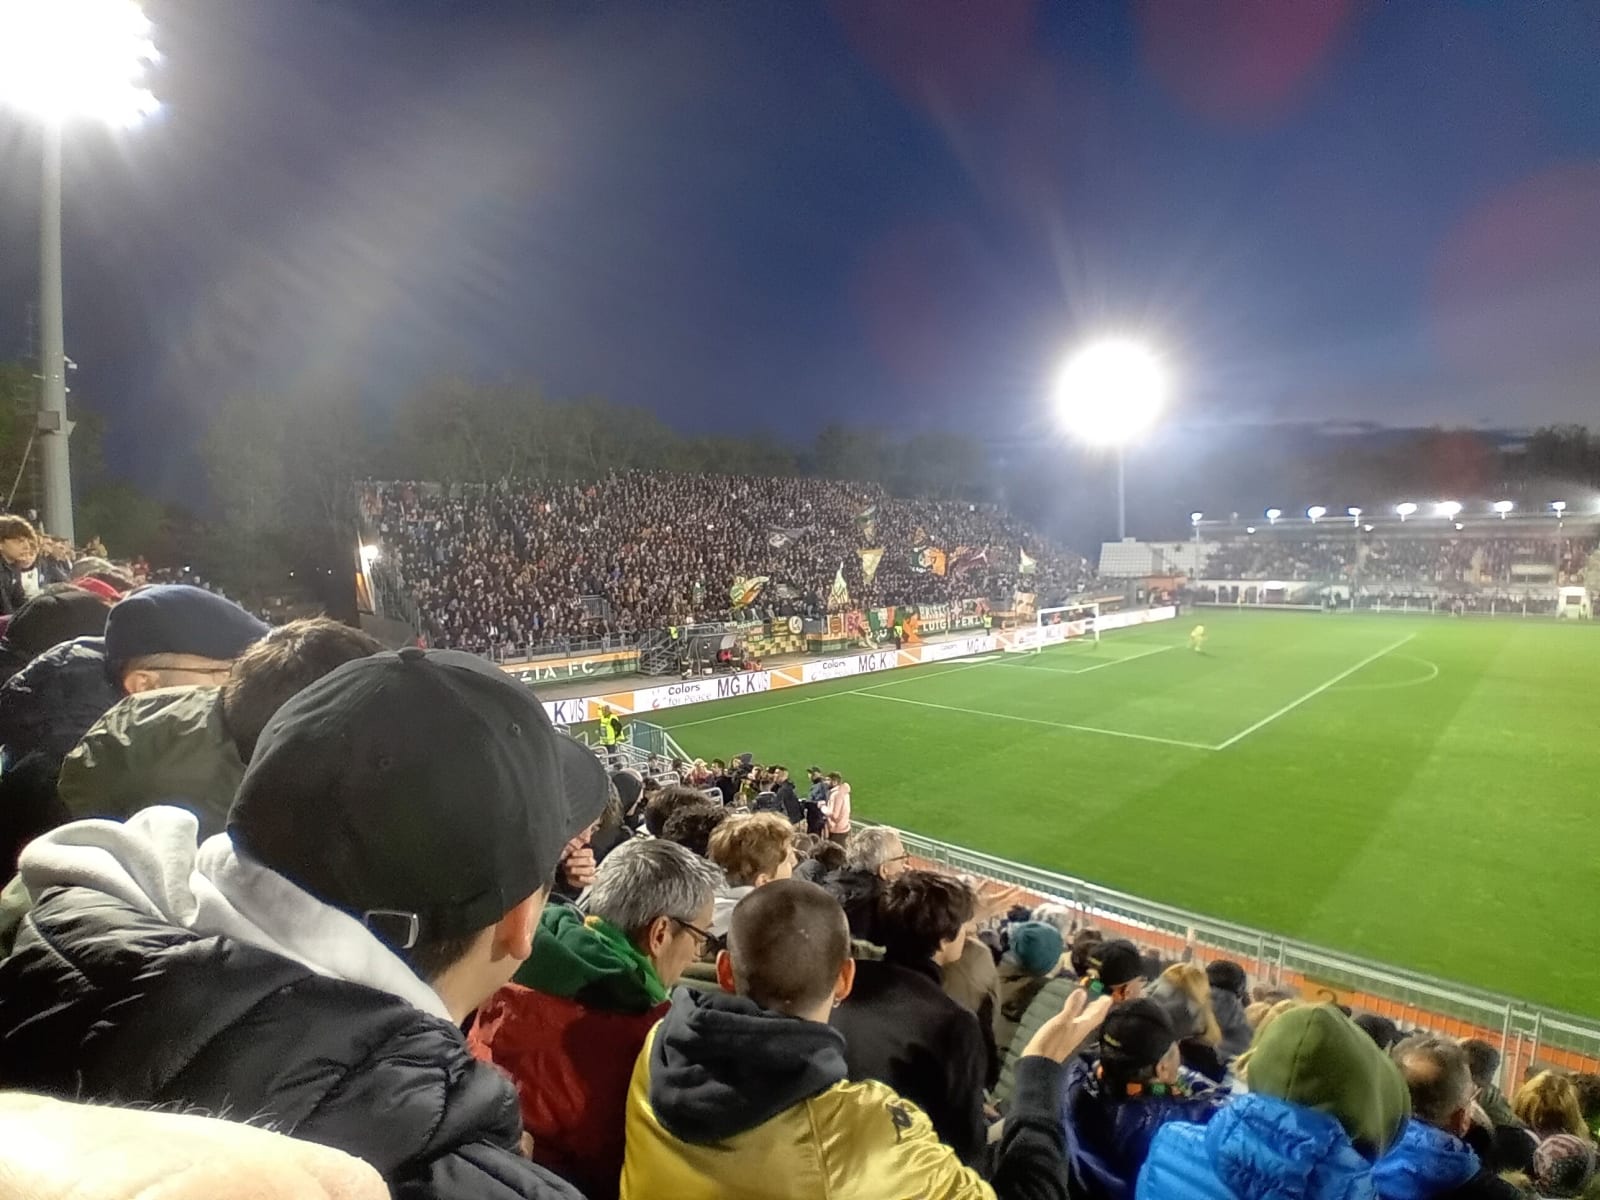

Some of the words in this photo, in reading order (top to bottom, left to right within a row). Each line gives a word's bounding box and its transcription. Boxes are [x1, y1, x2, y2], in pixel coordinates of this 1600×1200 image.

[955, 615, 984, 628] PENZ
[568, 660, 594, 676] FC
[668, 681, 700, 696] Colors
